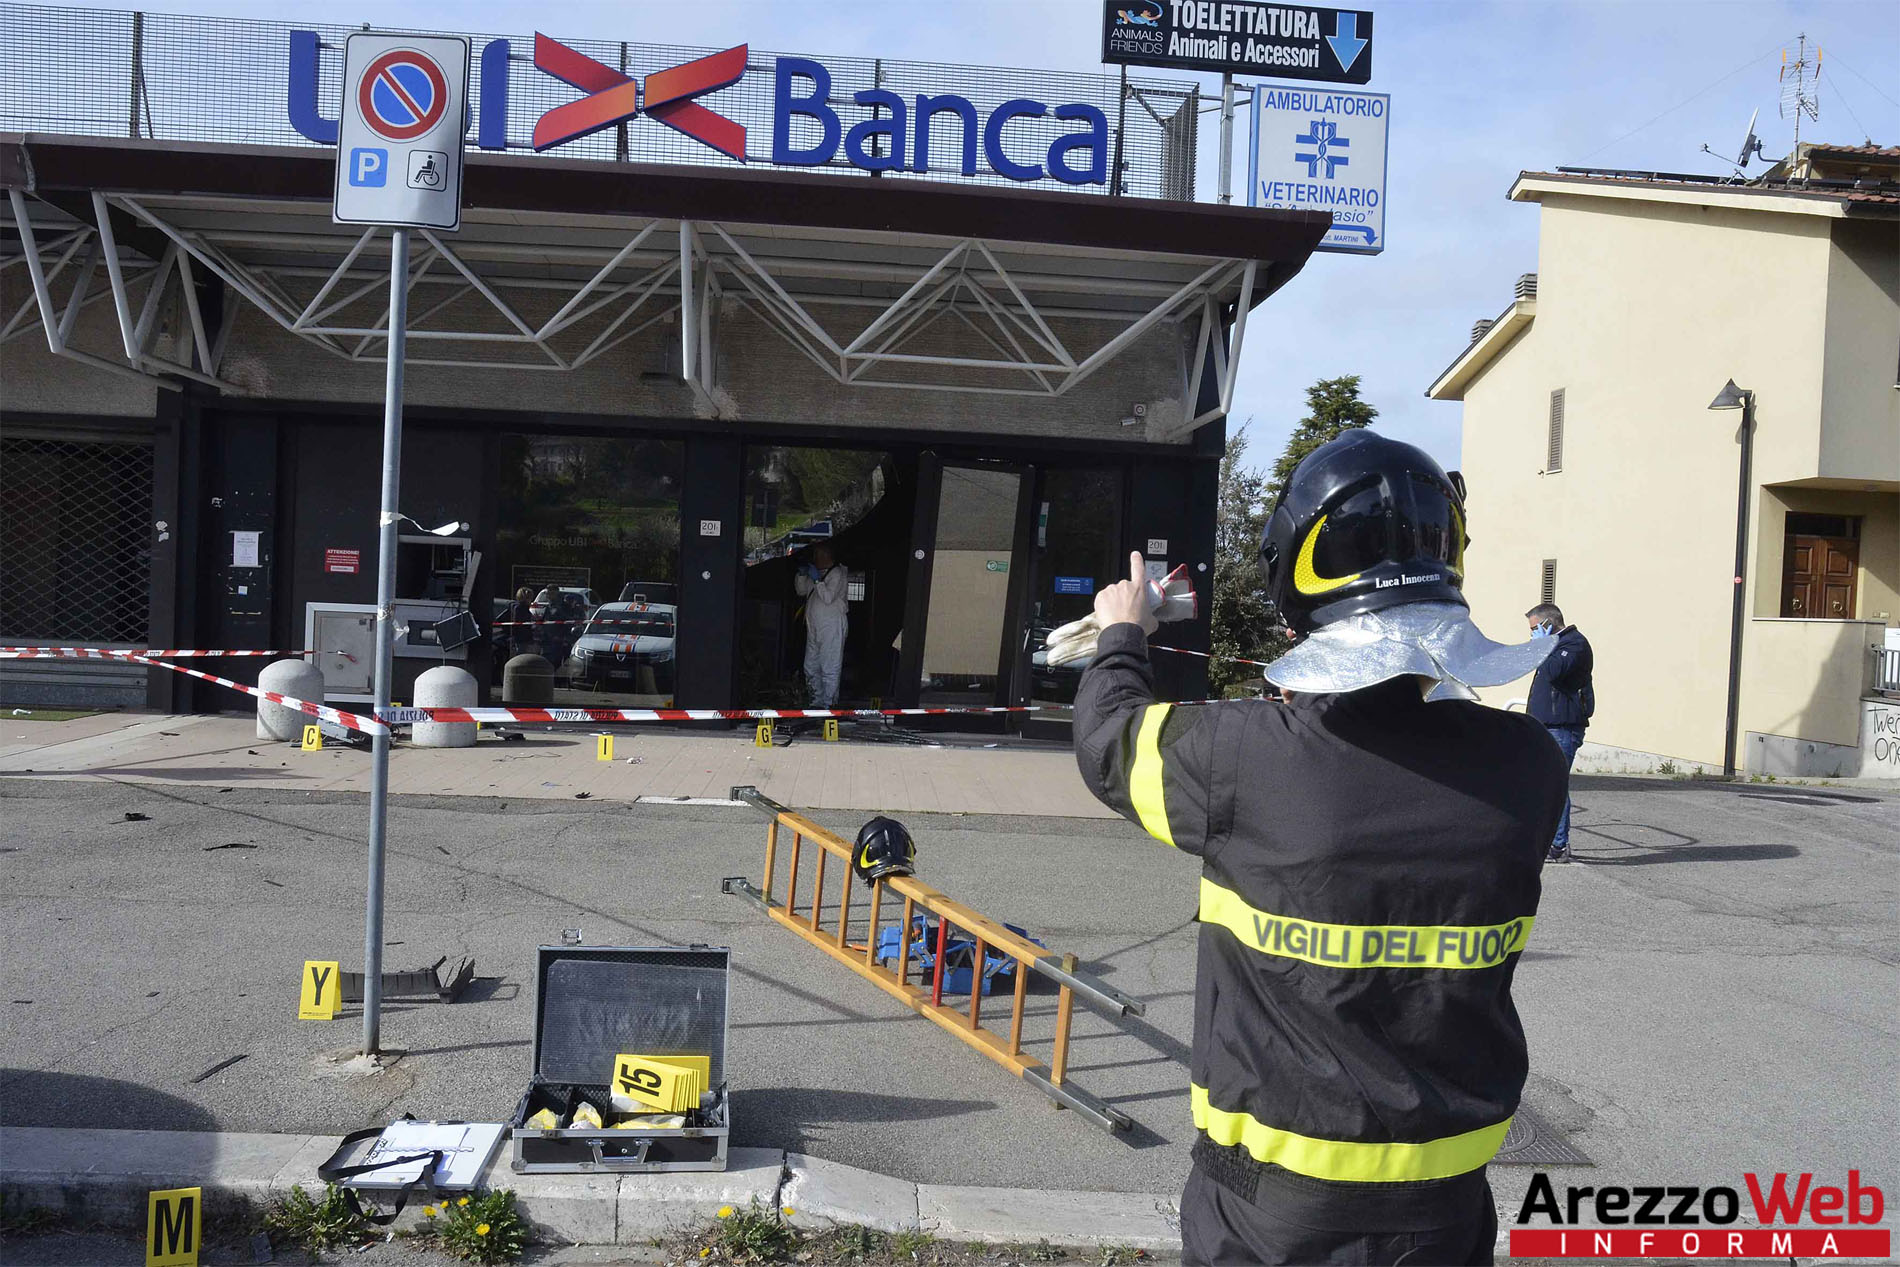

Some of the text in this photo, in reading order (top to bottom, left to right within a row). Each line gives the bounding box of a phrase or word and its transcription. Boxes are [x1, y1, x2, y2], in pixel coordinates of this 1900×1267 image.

[1169, 0, 1321, 40] TOELETTATURA
[1110, 40, 1163, 55] FRIENDS
[1111, 28, 1164, 42] ANIMALS
[1167, 32, 1320, 68] Animali e Accessori
[288, 30, 1108, 186] UI Banca
[1265, 91, 1384, 118] AMBULATORIO
[357, 152, 381, 182] P
[1261, 181, 1379, 207] VETERINARIO
[528, 534, 567, 549] Gruppo
[568, 536, 587, 546] UBI
[1375, 577, 1400, 589] Luca
[306, 727, 316, 745] C
[761, 727, 769, 743] G
[828, 721, 835, 737] F
[1252, 913, 1350, 963] VIGILI
[1360, 930, 1426, 963] DEL
[311, 966, 332, 1006] Y
[618, 1063, 662, 1098] 15
[153, 1196, 194, 1257] M
